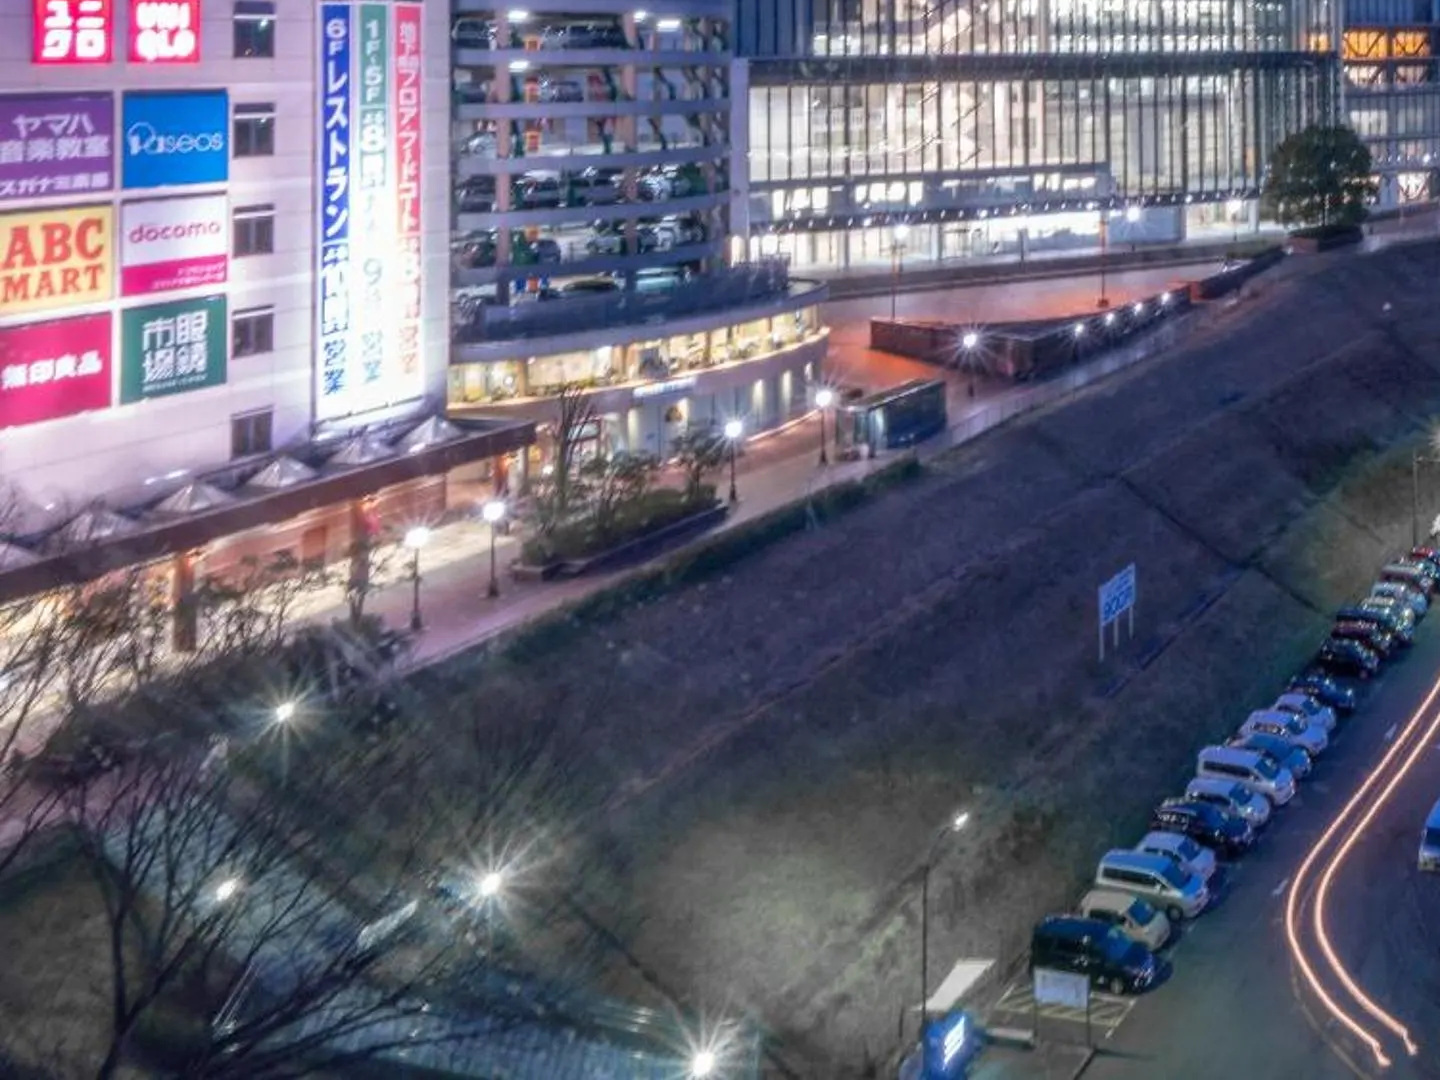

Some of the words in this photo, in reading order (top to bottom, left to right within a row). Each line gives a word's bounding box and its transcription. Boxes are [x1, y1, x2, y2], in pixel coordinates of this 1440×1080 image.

[12, 113, 95, 139] ヤマハ
[127, 121, 224, 156] Paseos
[325, 19, 349, 237] 6Fレストラン
[2, 217, 104, 270] ABC
[129, 222, 220, 244] docomo
[2, 264, 104, 302] MART
